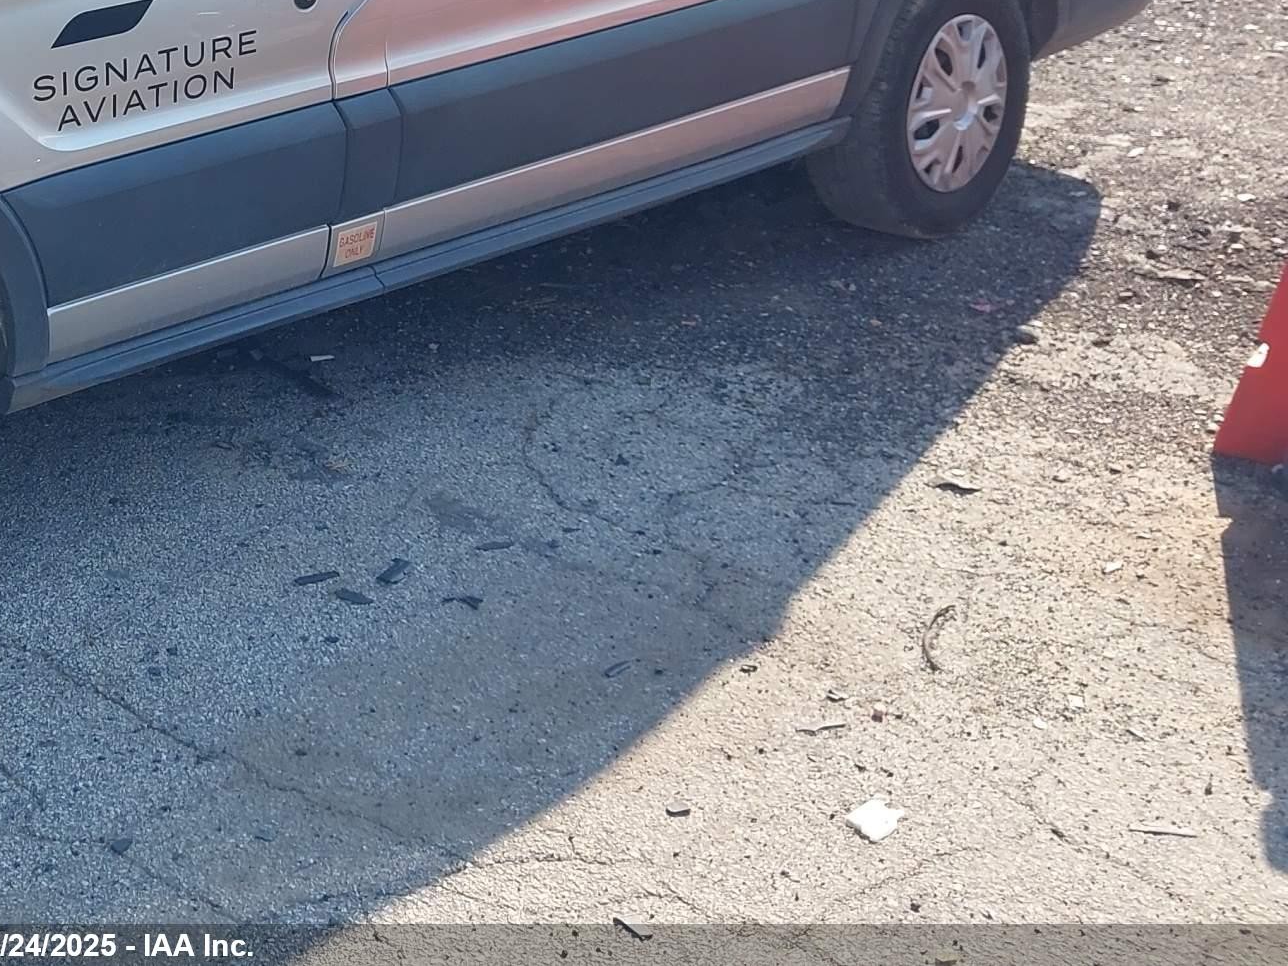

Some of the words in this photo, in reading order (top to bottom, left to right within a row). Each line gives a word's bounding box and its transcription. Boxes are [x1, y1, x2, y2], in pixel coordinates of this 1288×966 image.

[32, 30, 257, 102] SIGNATURE
[57, 67, 235, 132] AVIATION
[338, 227, 375, 248] GASOLINE
[344, 245, 362, 259] ONLY
